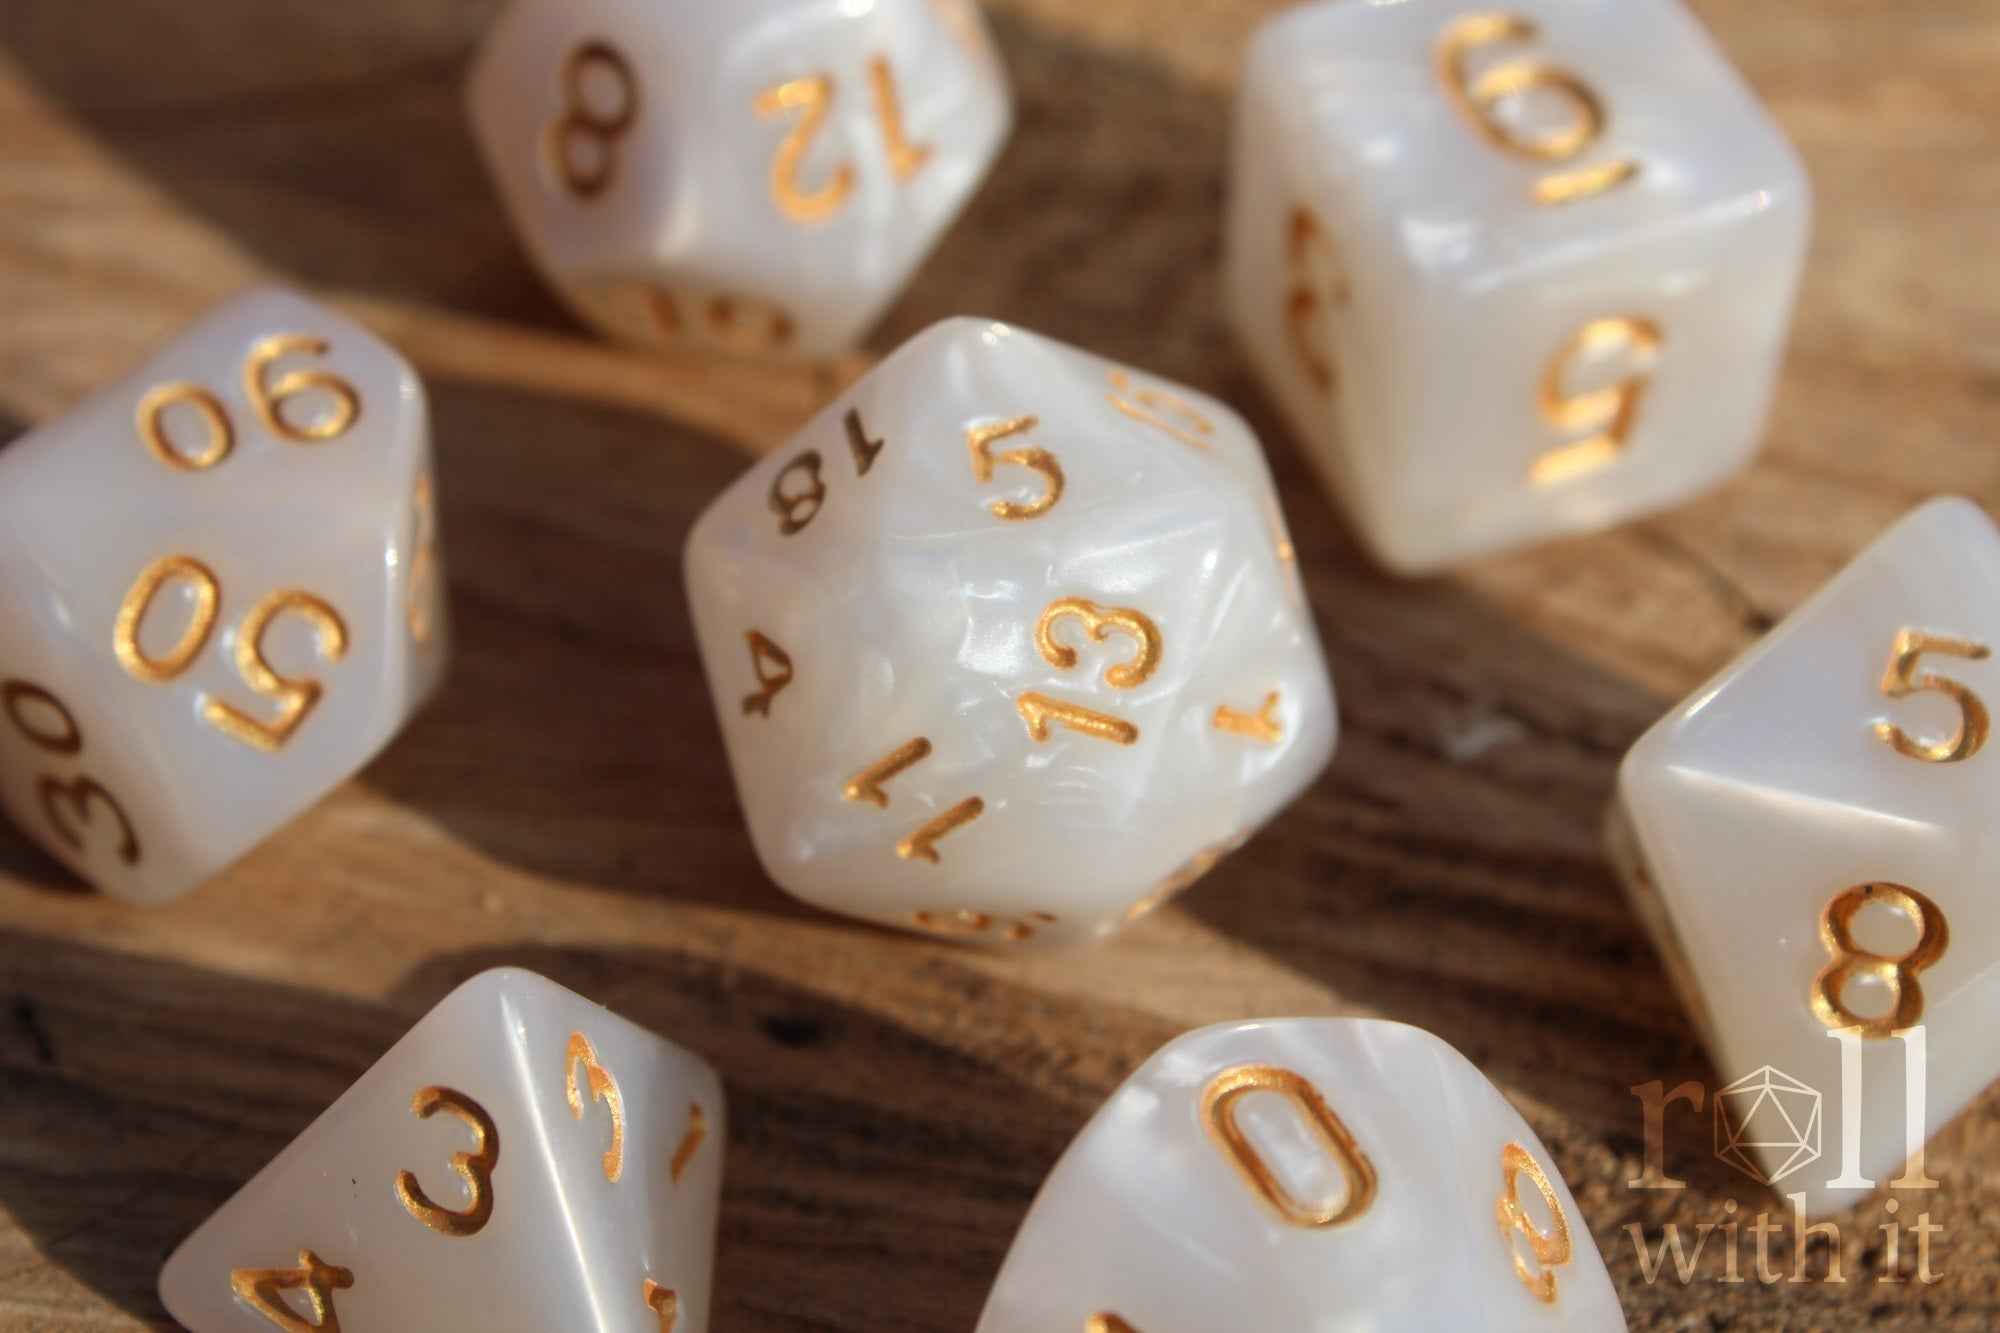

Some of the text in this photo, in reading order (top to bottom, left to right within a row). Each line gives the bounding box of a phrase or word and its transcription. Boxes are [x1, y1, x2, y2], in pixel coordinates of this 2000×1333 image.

[543, 40, 641, 205] 8
[752, 53, 936, 224] 12
[767, 407, 884, 537] 18
[964, 414, 1066, 521] 5
[1528, 316, 1666, 487] 5
[742, 629, 793, 720] 4
[1015, 597, 1163, 746] 13
[1872, 626, 1992, 764] 5
[841, 736, 986, 864] 11
[1810, 880, 1951, 1040] 8
[394, 1085, 501, 1238] 3
[1200, 1064, 1378, 1231] 0
